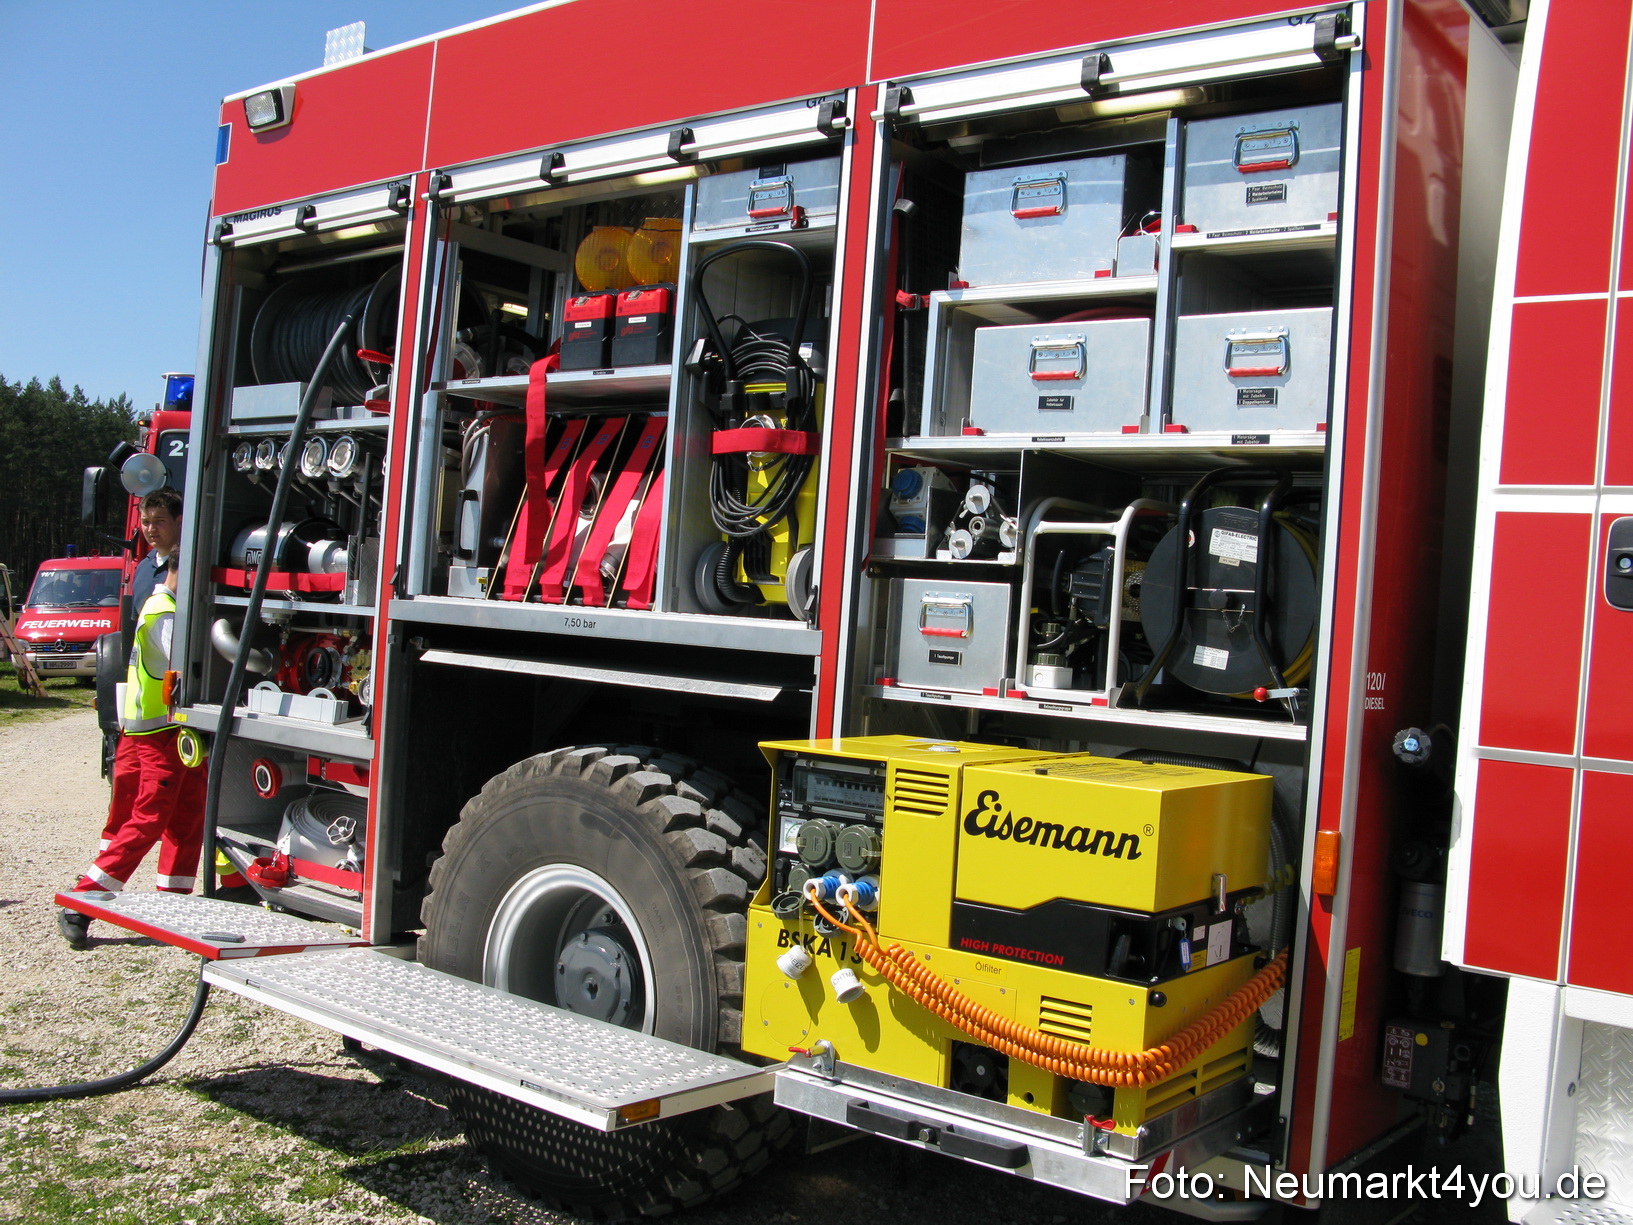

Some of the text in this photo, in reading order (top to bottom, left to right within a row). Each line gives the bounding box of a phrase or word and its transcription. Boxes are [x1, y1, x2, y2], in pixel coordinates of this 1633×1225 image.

[234, 205, 282, 224] MAGIRUS
[168, 440, 190, 456] 2
[641, 435, 654, 448] B
[1221, 530, 1257, 542] GIFAS-ELECTRIC
[21, 619, 111, 630] FEUERWEHR
[564, 617, 596, 628] 7,50 bar
[1365, 697, 1385, 710] DIESEL
[964, 790, 1142, 860] Eisemann
[777, 928, 832, 958] BSKA
[960, 937, 1064, 966] HIGH PROTECTION
